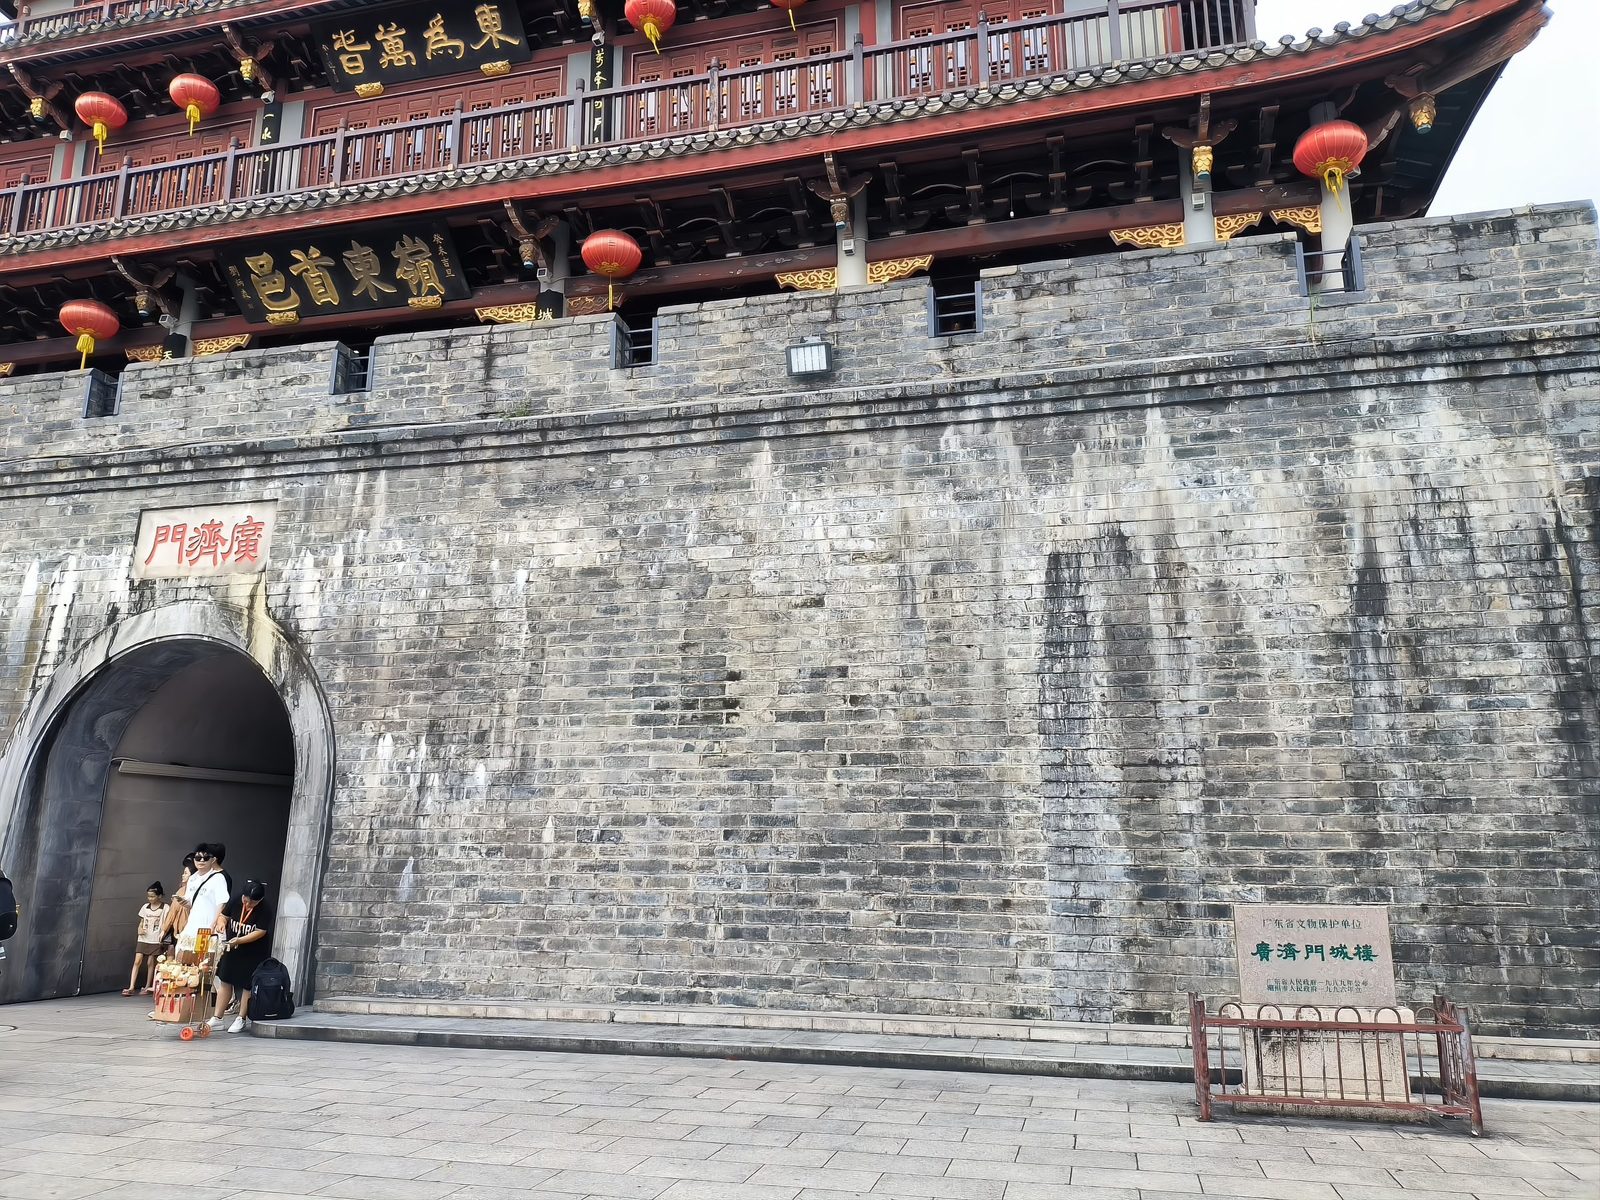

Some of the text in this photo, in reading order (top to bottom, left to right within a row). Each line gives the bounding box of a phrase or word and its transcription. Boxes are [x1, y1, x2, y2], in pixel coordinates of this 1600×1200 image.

[1262, 918, 1363, 930] 广东省文物保护单位
